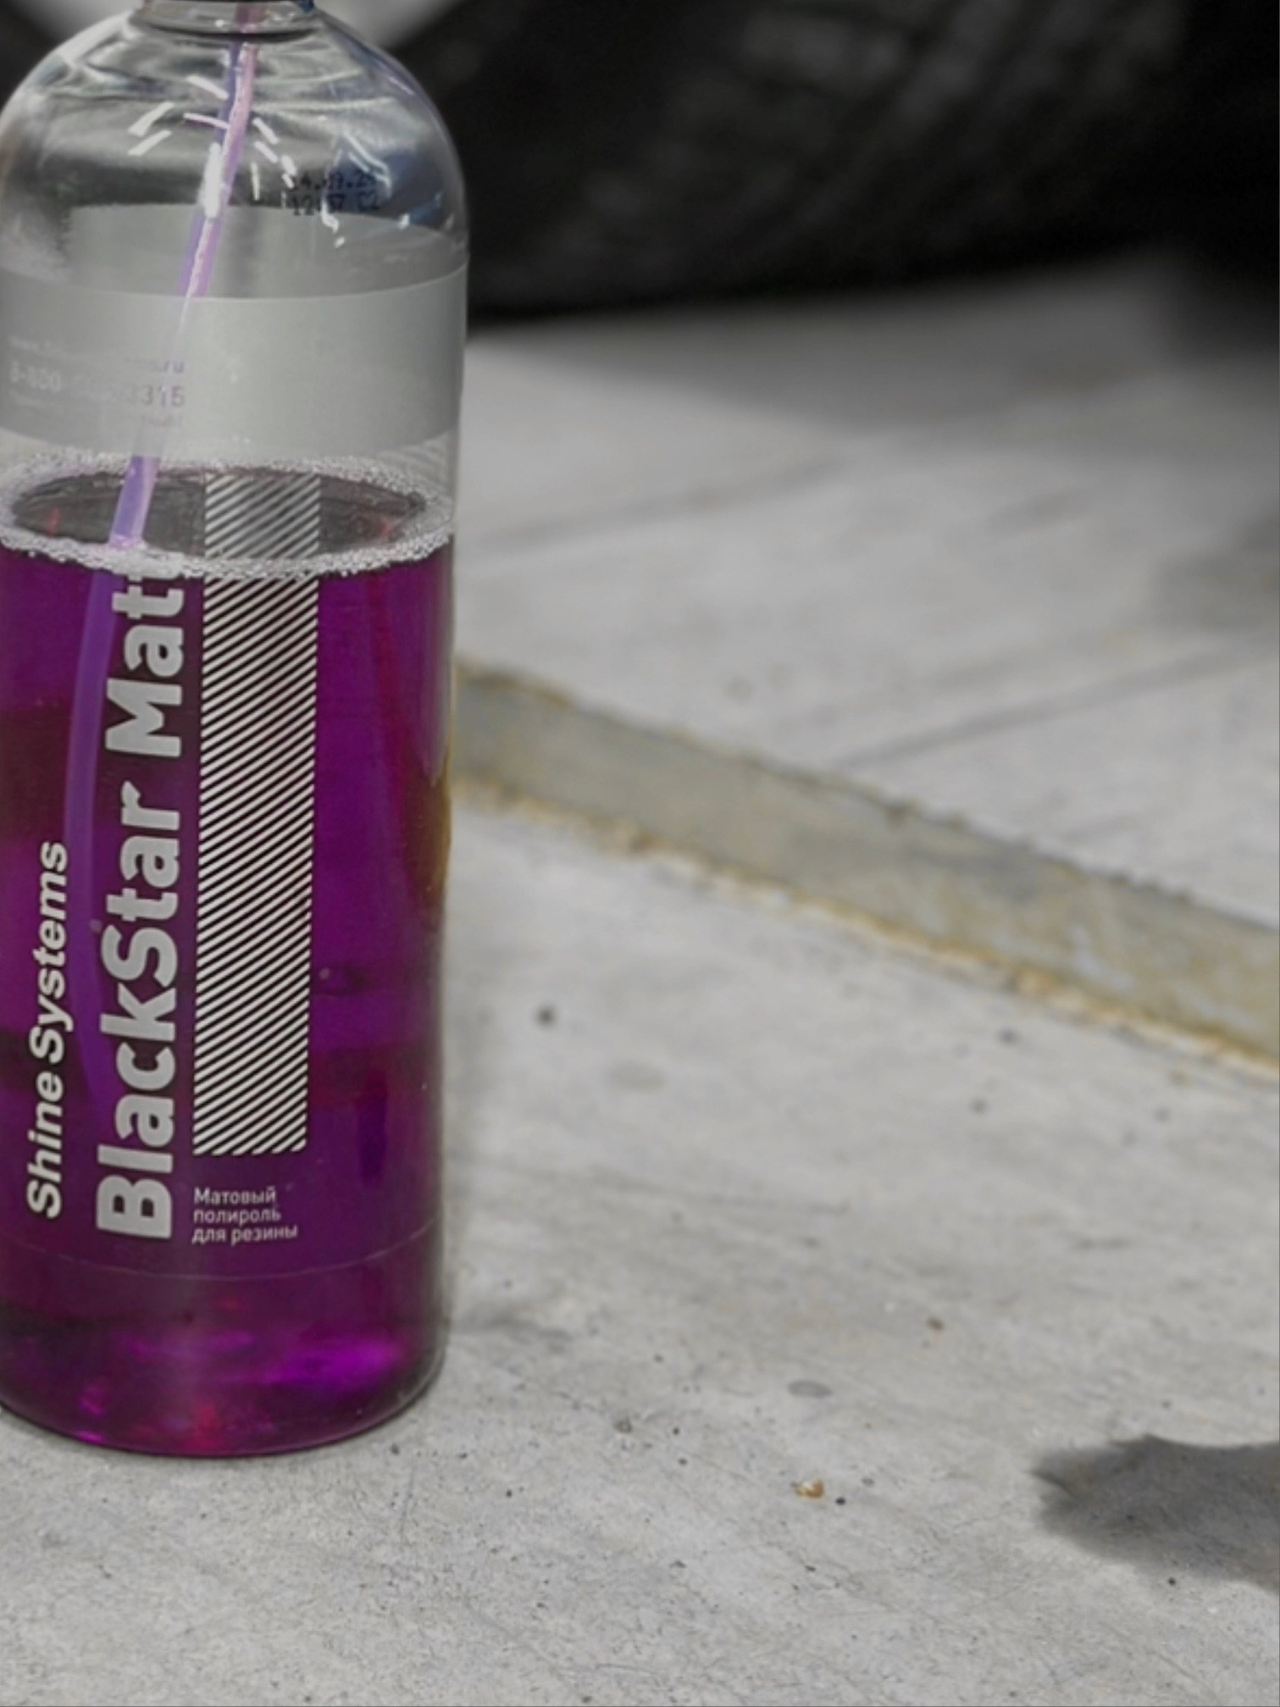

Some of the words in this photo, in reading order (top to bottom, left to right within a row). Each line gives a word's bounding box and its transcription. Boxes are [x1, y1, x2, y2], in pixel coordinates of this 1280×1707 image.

[29, 841, 74, 1064] Systems
[95, 780, 180, 1240] BlackStar
[26, 1071, 63, 1219] Shine
[191, 1228, 227, 1245] для
[230, 1224, 299, 1247] резины
[193, 1208, 282, 1228] полироль
[194, 1185, 277, 1206] Матовый
